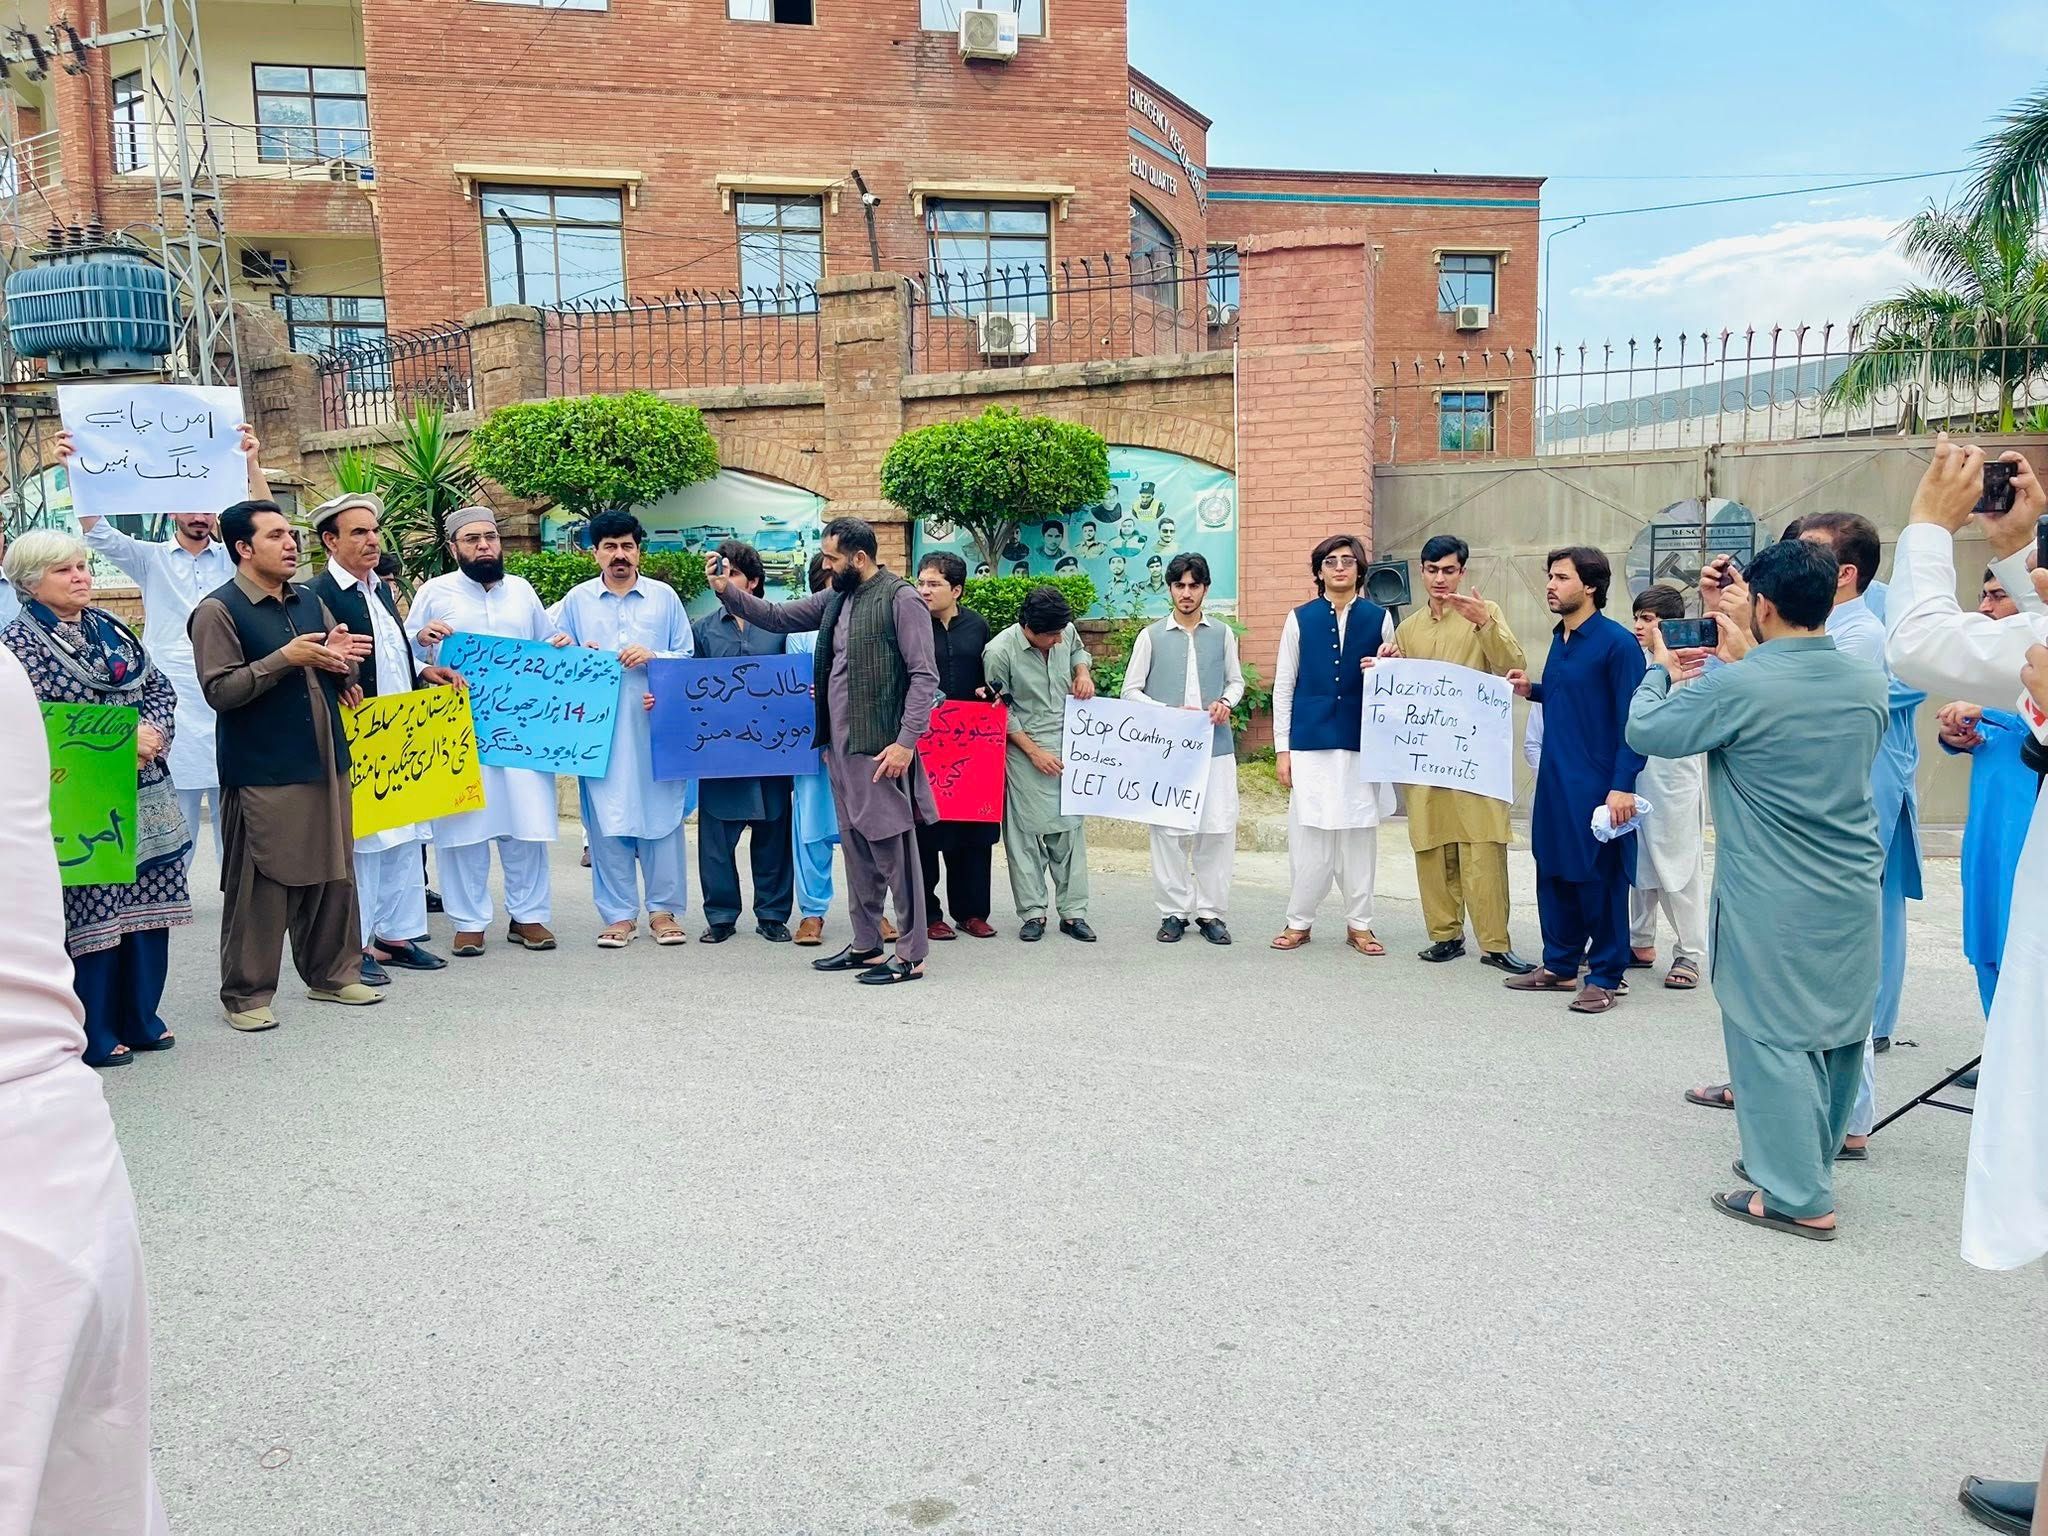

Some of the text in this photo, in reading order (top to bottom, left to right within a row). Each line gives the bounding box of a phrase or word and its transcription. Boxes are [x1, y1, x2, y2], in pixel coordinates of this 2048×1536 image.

[1129, 87, 1168, 135] EMERGENCY
[1129, 153, 1178, 197] HEAD QUARTER
[161, 411, 214, 438] امن
[80, 445, 210, 479] جنگ نہیں
[523, 657, 546, 674] 22
[747, 667, 809, 711] طالب
[1374, 674, 1463, 697] Waziristan
[364, 703, 403, 738] مسلط
[417, 692, 465, 727] وزیرستان
[529, 696, 561, 724] ہزار
[564, 701, 586, 723] 14
[587, 706, 610, 724] اور
[1369, 704, 1386, 724] To
[1404, 704, 1459, 728] Pashtuns
[684, 721, 732, 751] منو
[1070, 709, 1204, 759] Stop Counting our
[1394, 731, 1468, 752] Not To
[535, 742, 578, 766] باوجود
[581, 744, 603, 760] کے
[1409, 753, 1479, 780] Terrorists
[1071, 769, 1201, 814] LET US LIVE!
